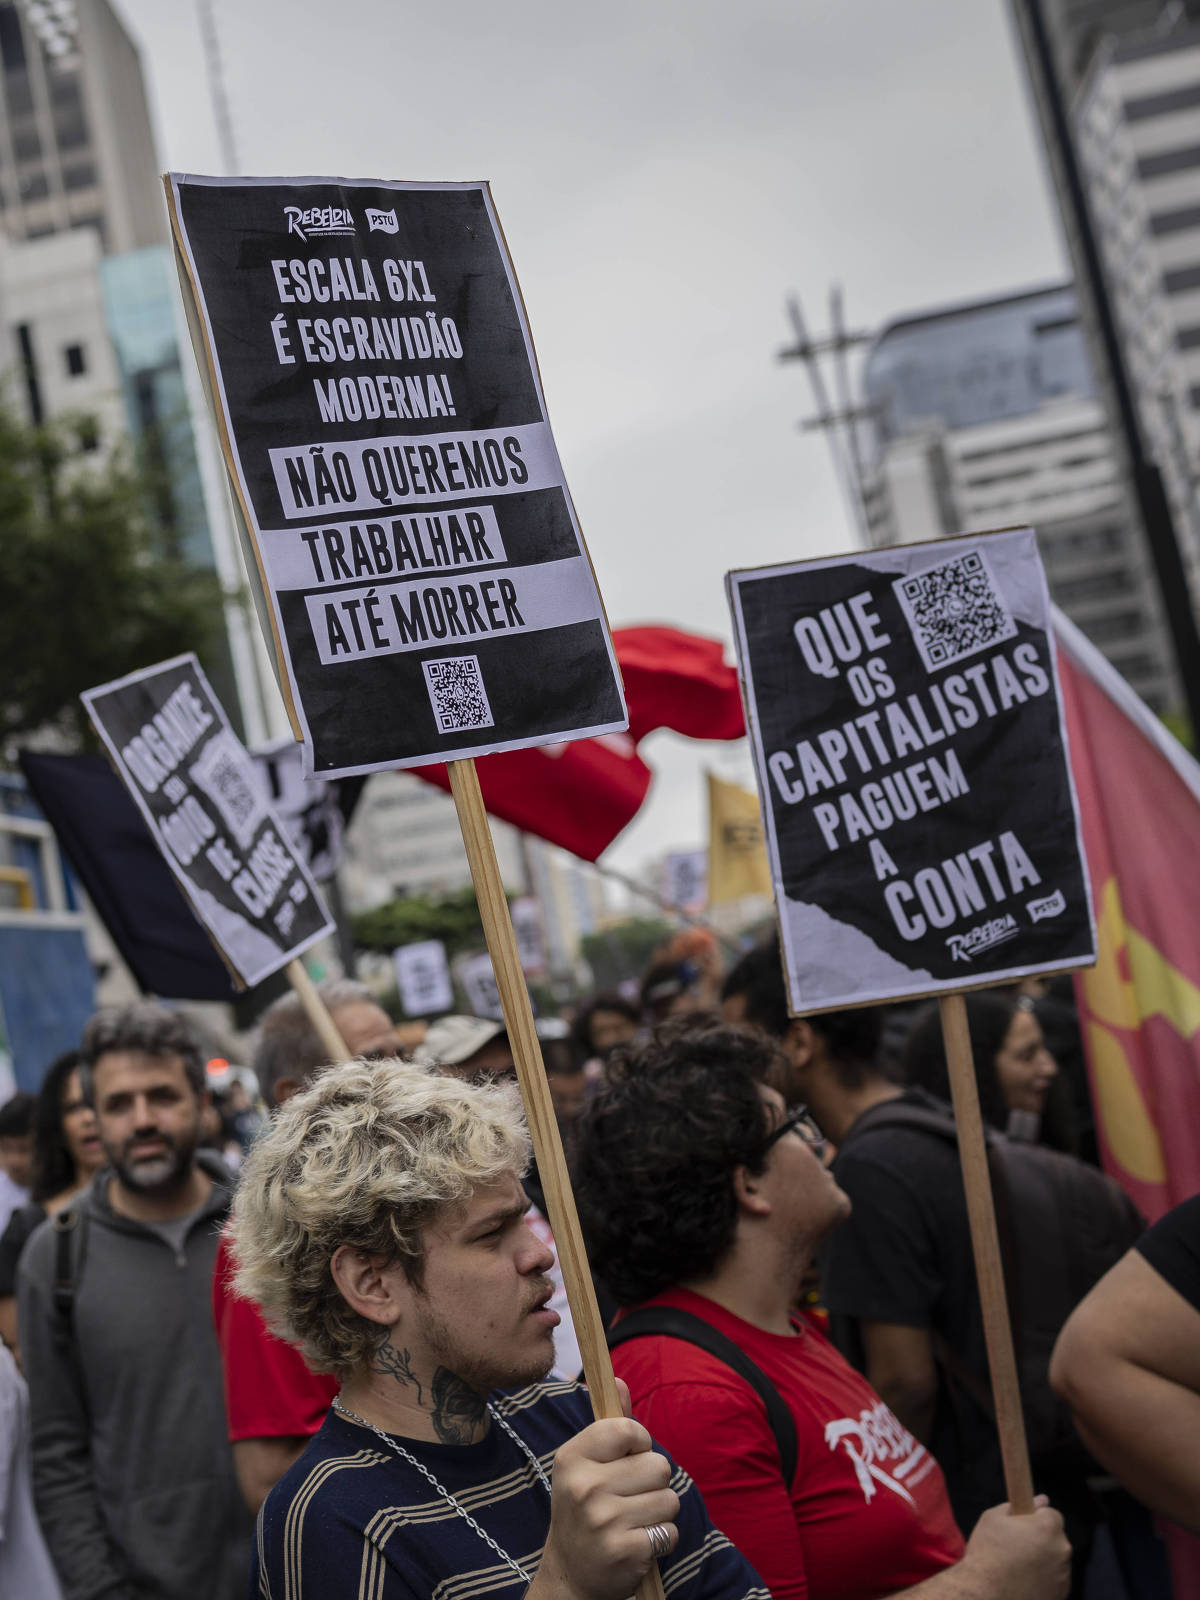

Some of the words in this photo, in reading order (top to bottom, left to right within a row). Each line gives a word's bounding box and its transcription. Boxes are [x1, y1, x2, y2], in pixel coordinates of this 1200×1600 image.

[271, 257, 381, 304] ESCALA
[383, 260, 437, 303] 6X1
[271, 313, 296, 365] É
[297, 312, 464, 363] ESCRAVIDÃO
[313, 374, 457, 424] MODERNA!
[284, 446, 358, 509] NÃO
[361, 435, 529, 506] QUEREMOS
[301, 511, 495, 583] TRABALHAR
[322, 580, 390, 656] ATÉ
[390, 578, 526, 645] MORRER
[793, 590, 892, 679] QUE
[847, 657, 896, 707] OS
[767, 642, 1051, 805] CAPITALISTAS
[813, 748, 971, 851] PAGUEM
[868, 838, 899, 881] A
[883, 830, 1042, 942] CONTA
